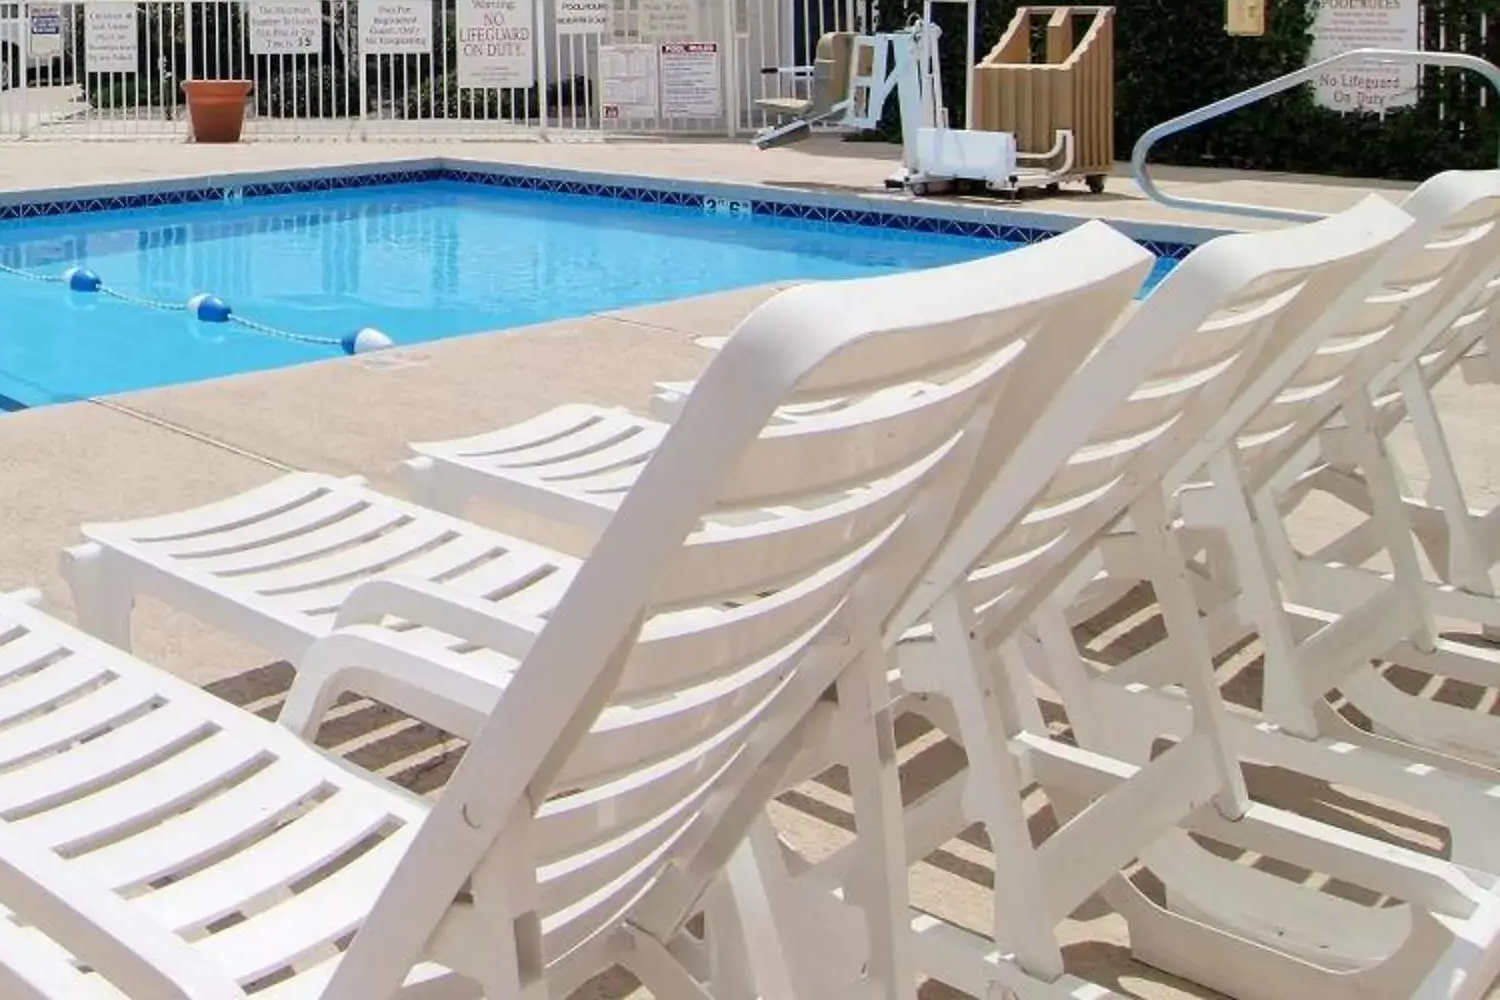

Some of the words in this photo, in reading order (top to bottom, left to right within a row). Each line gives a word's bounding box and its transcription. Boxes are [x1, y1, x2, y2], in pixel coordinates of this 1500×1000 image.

[484, 11, 506, 27] NO
[460, 27, 530, 42] LIFEGUARD
[463, 43, 483, 57] ON
[1320, 73, 1338, 87] No
[1341, 73, 1400, 90] Lifeguard
[1333, 90, 1351, 104] On
